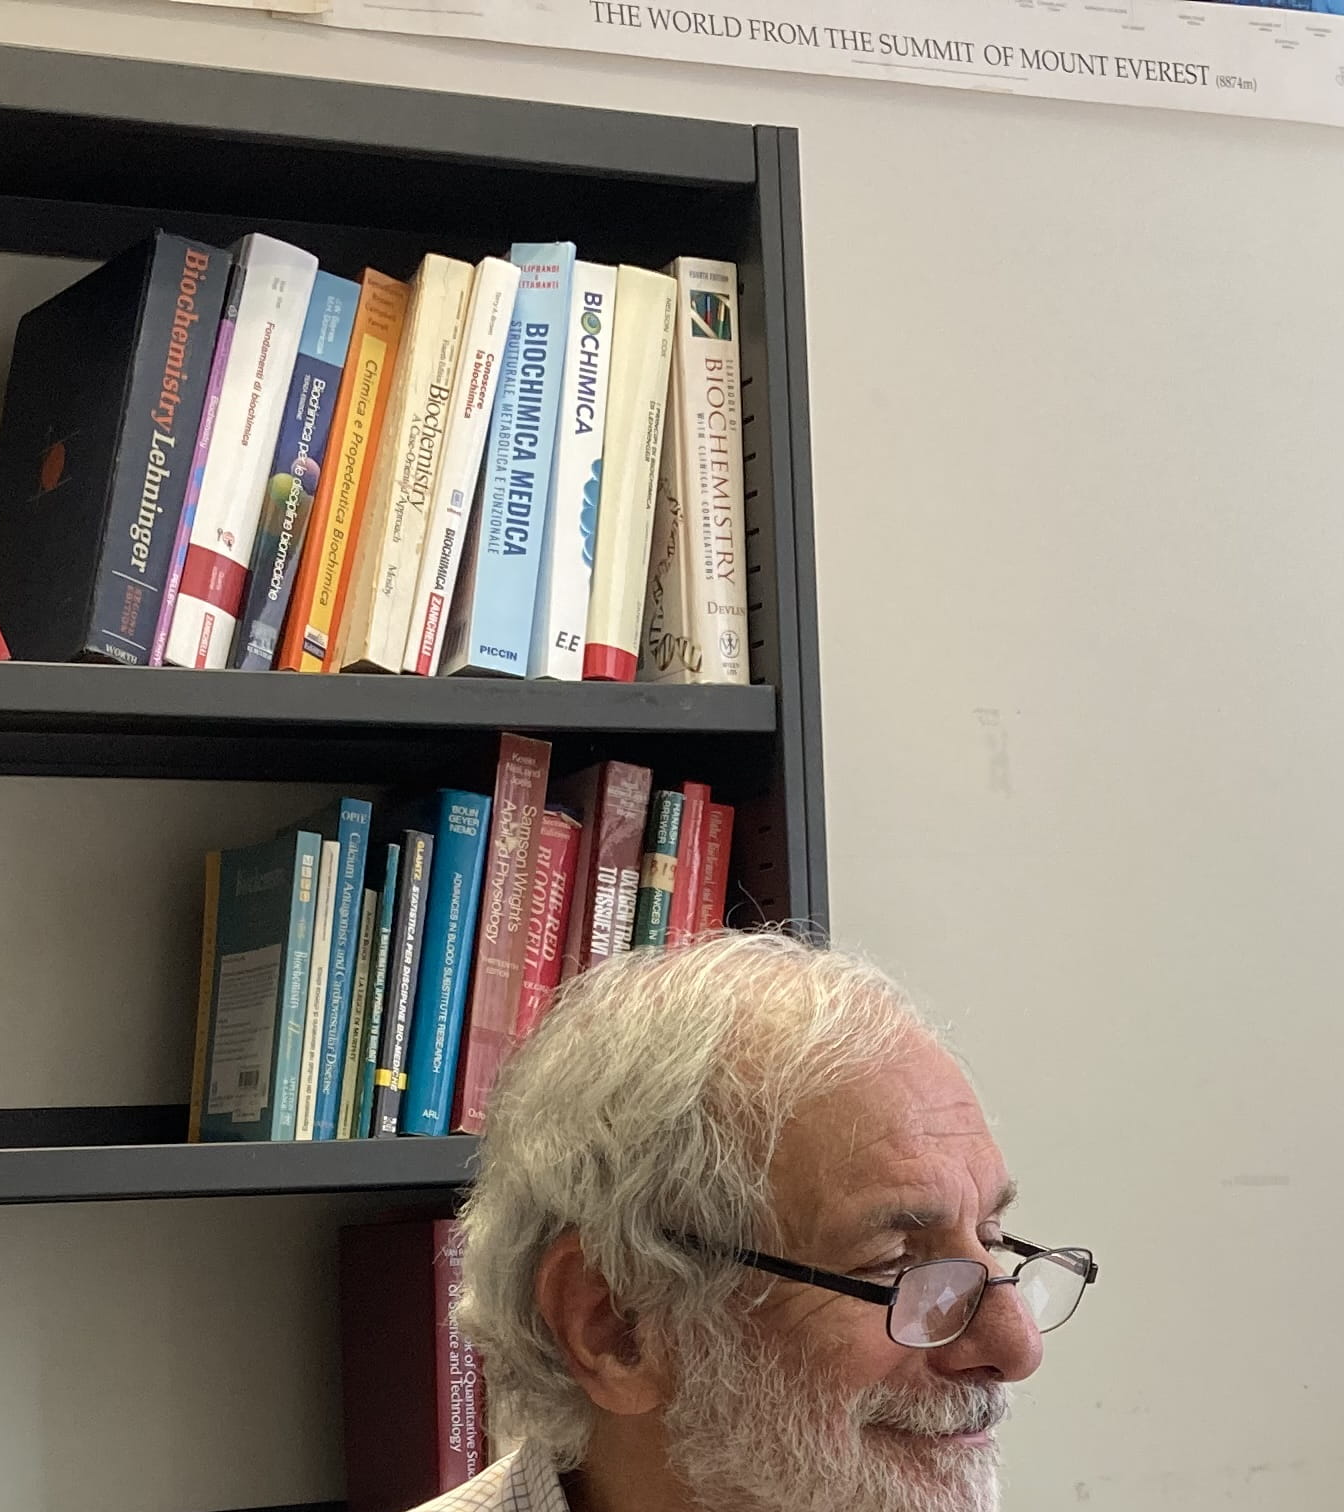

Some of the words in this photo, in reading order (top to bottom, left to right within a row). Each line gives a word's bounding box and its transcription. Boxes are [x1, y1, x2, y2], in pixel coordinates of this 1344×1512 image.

[589, 0, 642, 28] THE
[648, 7, 742, 38] WORLD
[748, 18, 820, 48] FROM
[825, 27, 875, 53] THE
[879, 33, 975, 64] SUMMIT
[983, 44, 1015, 68] OF
[1020, 47, 1111, 78] MOUNT
[1116, 56, 1211, 86] EVEREST
[151, 246, 208, 432] Biochemistry
[255, 321, 275, 379] Fondamenti
[503, 320, 522, 398] STRUTTURALE,
[252, 380, 264, 391] di
[301, 377, 324, 441] Biochimica
[356, 358, 377, 416] Chimica
[476, 353, 494, 409] Conoscere
[513, 321, 548, 462] BIOCHIMICA
[241, 392, 260, 446] biochimica
[353, 419, 362, 428] e
[496, 403, 514, 471] METABOLICA
[293, 464, 308, 476] le
[294, 442, 307, 464] per
[405, 383, 449, 512] Biochemistry
[707, 357, 733, 586] BIOCHEMISTRY
[125, 429, 173, 573] Lehninger
[281, 477, 303, 531] discipline
[334, 431, 362, 523] Propedeutica
[487, 486, 505, 554] FUNZIONALE
[504, 469, 533, 557] MEDICA
[268, 531, 291, 601] biomediche
[319, 528, 344, 606] Biochimica
[382, 563, 398, 597] Mosby
[434, 527, 455, 590] BIOCHIMICA
[420, 596, 441, 655] ZANICHELLI
[479, 645, 517, 661] PICCIN
[448, 814, 480, 827] GEYER
[449, 823, 477, 837] NEMO
[514, 804, 536, 868] Samson
[658, 800, 669, 843] BREWER
[345, 832, 360, 878] Calcium
[596, 865, 617, 884] TO
[336, 881, 355, 943] Antagonists
[406, 885, 419, 941] STATISTICA
[450, 872, 463, 920] ADVANCES
[504, 870, 527, 932] Wright's
[549, 870, 565, 909] THE
[594, 885, 613, 930] TISSUE
[404, 942, 413, 963] PER
[444, 933, 456, 964] BLOOD
[448, 922, 458, 931] IN
[542, 915, 559, 961] RED
[589, 930, 610, 955] XVI
[290, 950, 307, 1009] Biochemistry
[336, 947, 347, 969] and
[327, 970, 345, 1050] Cardiovascular
[398, 965, 410, 1021] DISCIPLINE
[438, 966, 451, 1021] SUBSTITUTE
[322, 1052, 336, 1094] Disease
[389, 1022, 404, 1091] BIO-MEDICHE
[432, 1023, 445, 1072] RESEARCH
[463, 1356, 475, 1367] of
[462, 1370, 478, 1448] Quantitative
